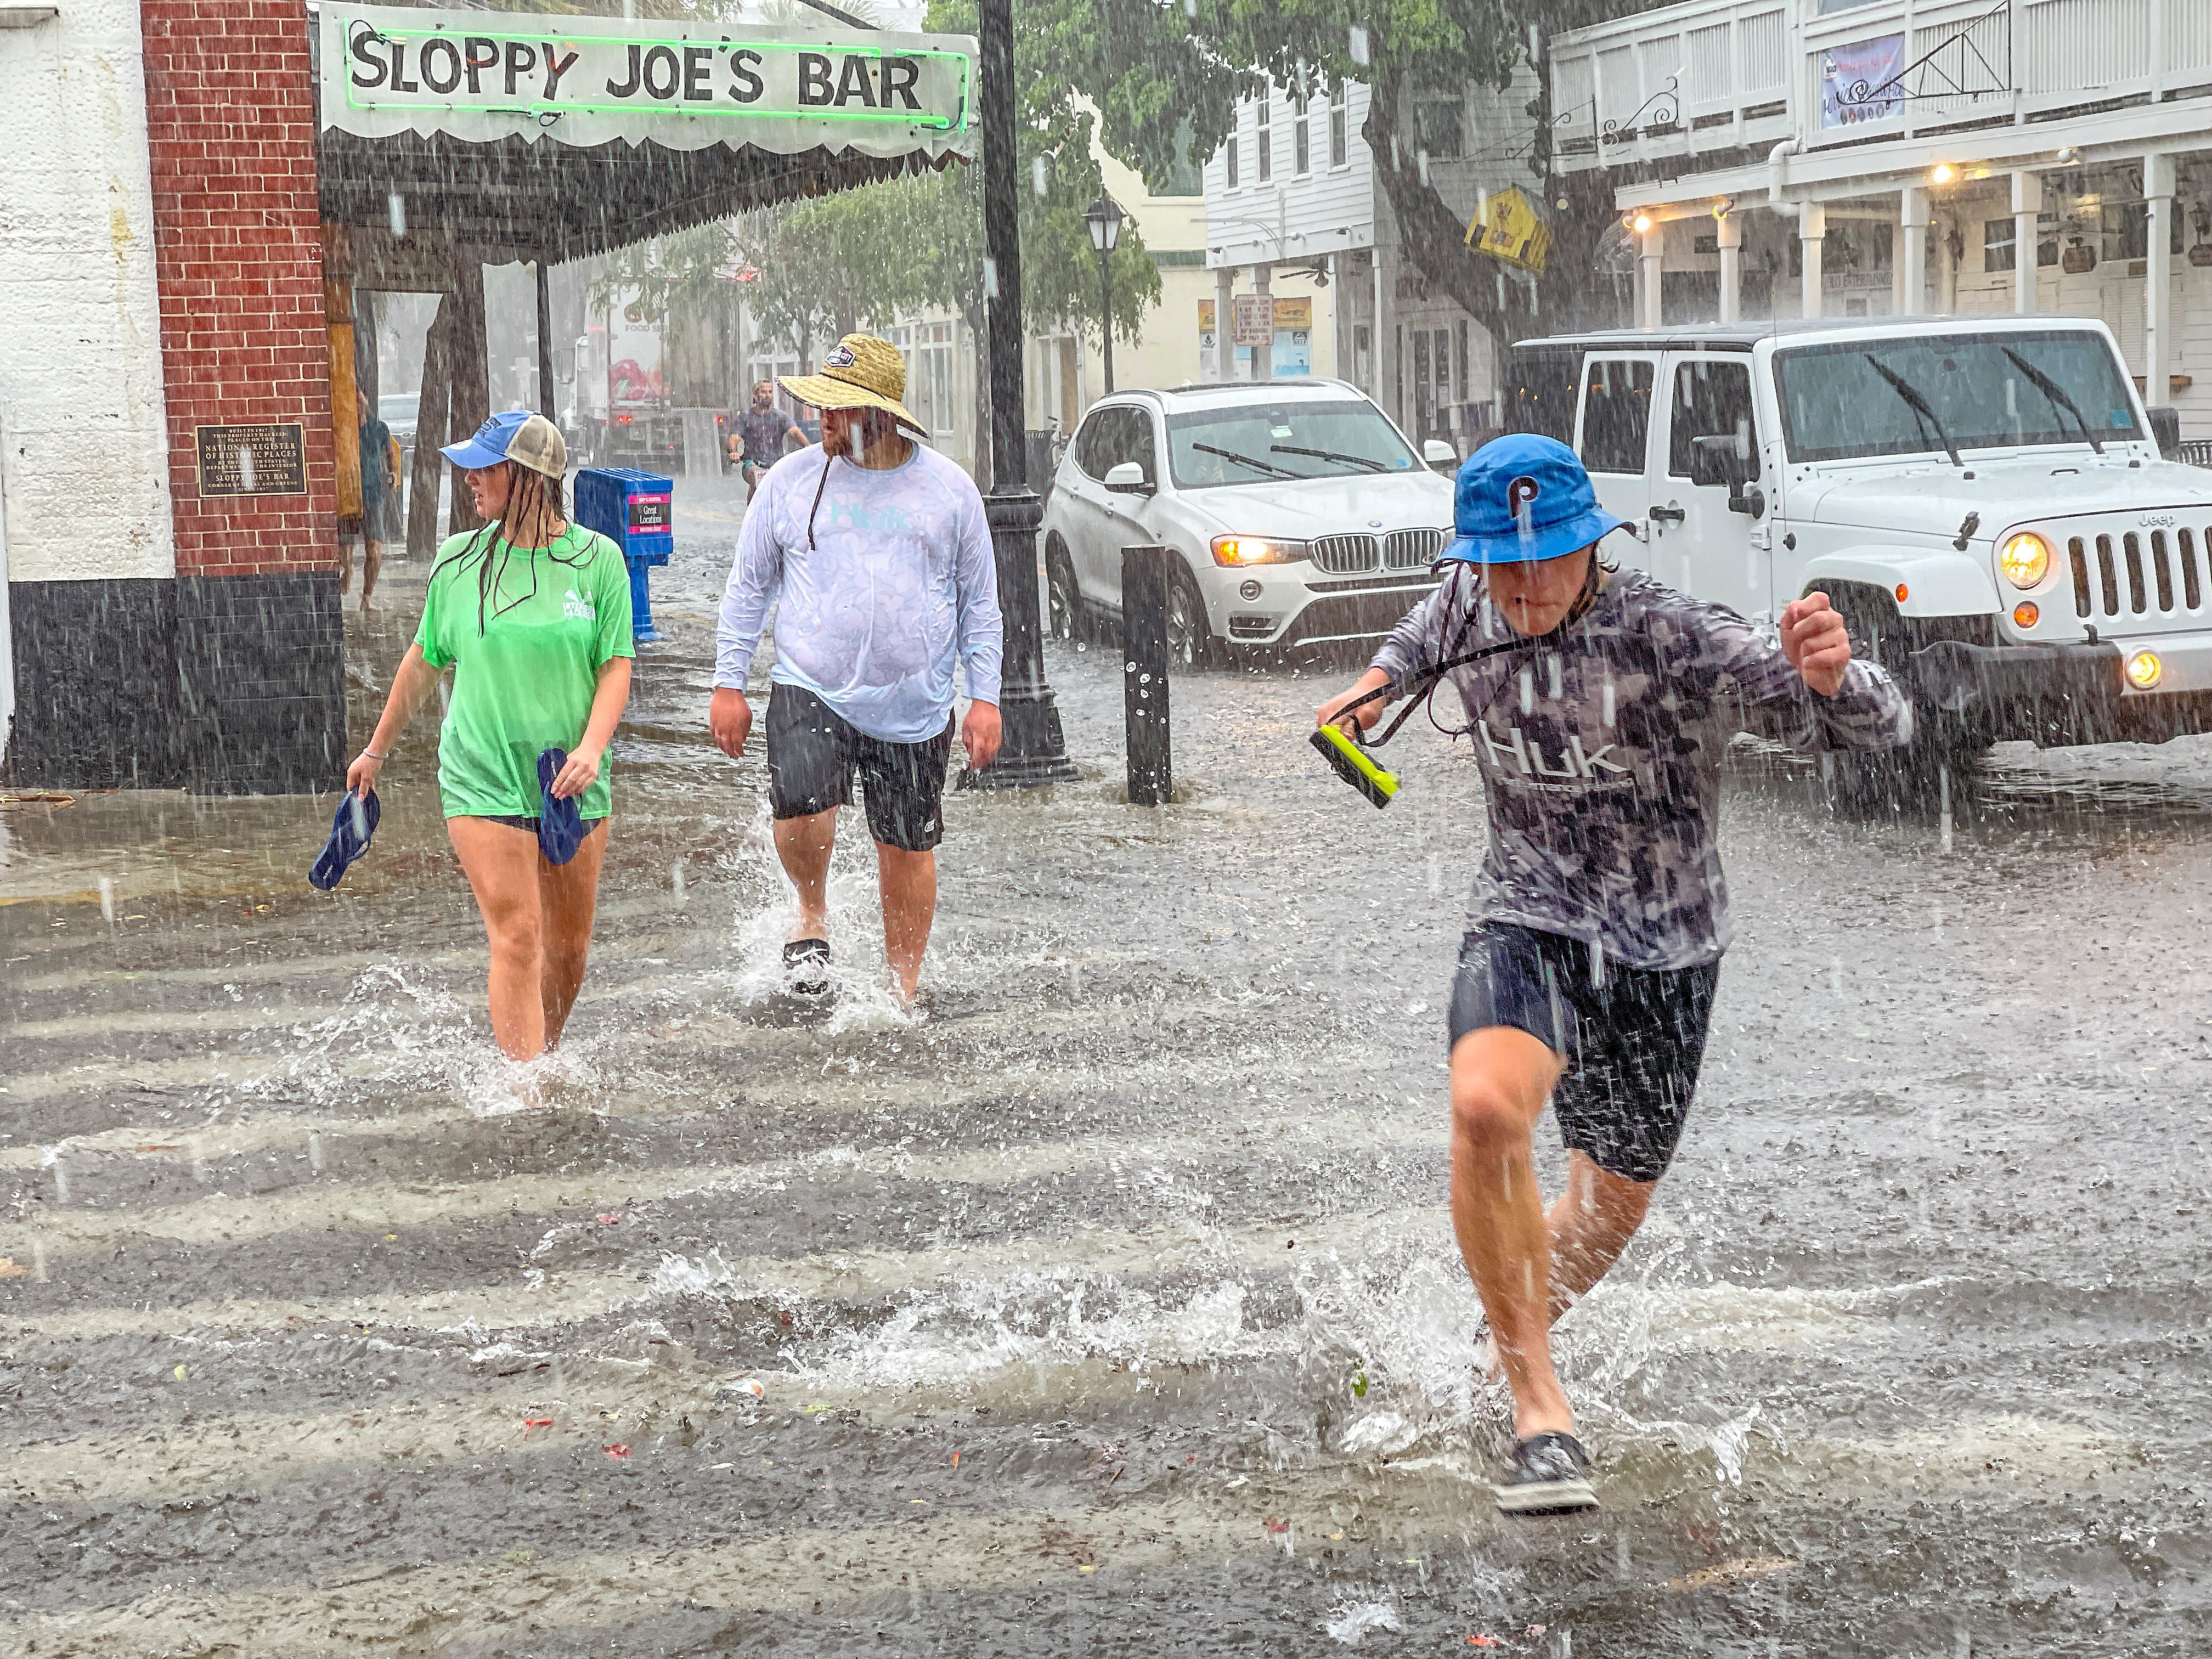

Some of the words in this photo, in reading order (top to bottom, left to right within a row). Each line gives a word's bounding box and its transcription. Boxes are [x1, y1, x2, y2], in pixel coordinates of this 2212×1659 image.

[351, 31, 579, 102] SLOPPY
[606, 36, 764, 103] JOE'S
[798, 52, 922, 110] BAR
[205, 443, 250, 452] NATIONAL
[252, 442, 296, 450] REGISTER
[643, 505, 657, 515] Great
[640, 515, 662, 524] Locations
[2139, 513, 2176, 528] Jeep
